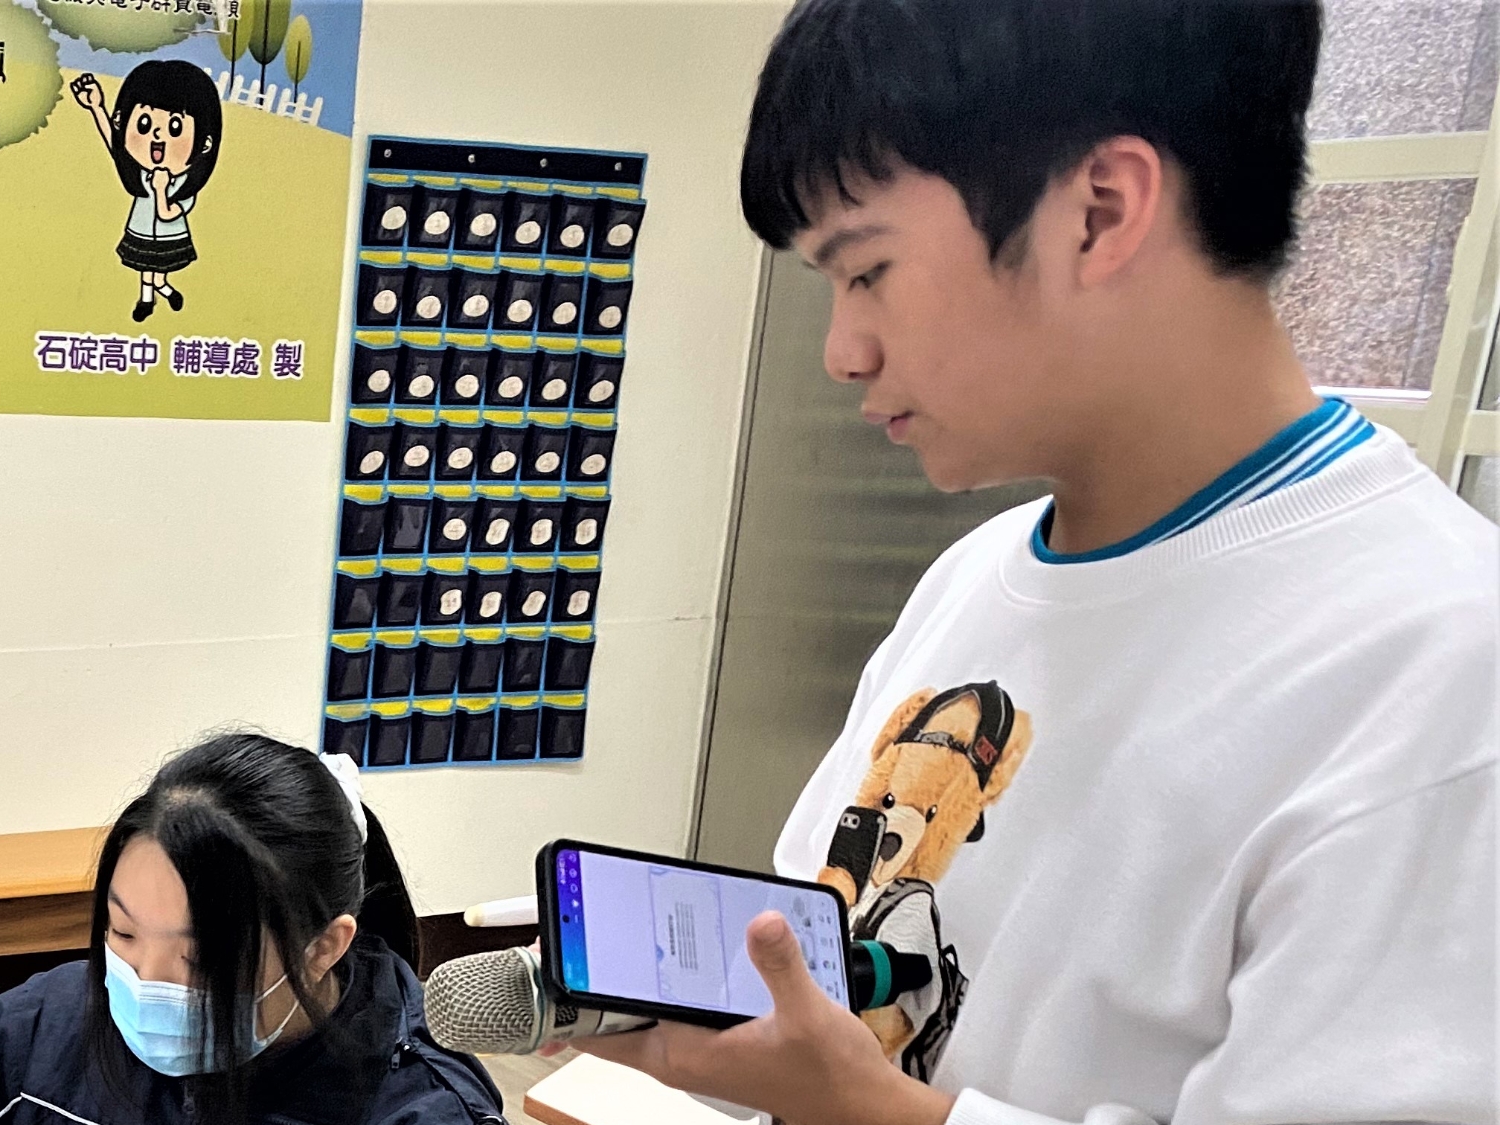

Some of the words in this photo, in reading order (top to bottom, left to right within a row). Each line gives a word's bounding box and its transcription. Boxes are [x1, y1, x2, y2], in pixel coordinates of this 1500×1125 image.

[37, 335, 157, 373] 石碇高中
[174, 341, 259, 377] 輔導處
[275, 345, 303, 378] 製
